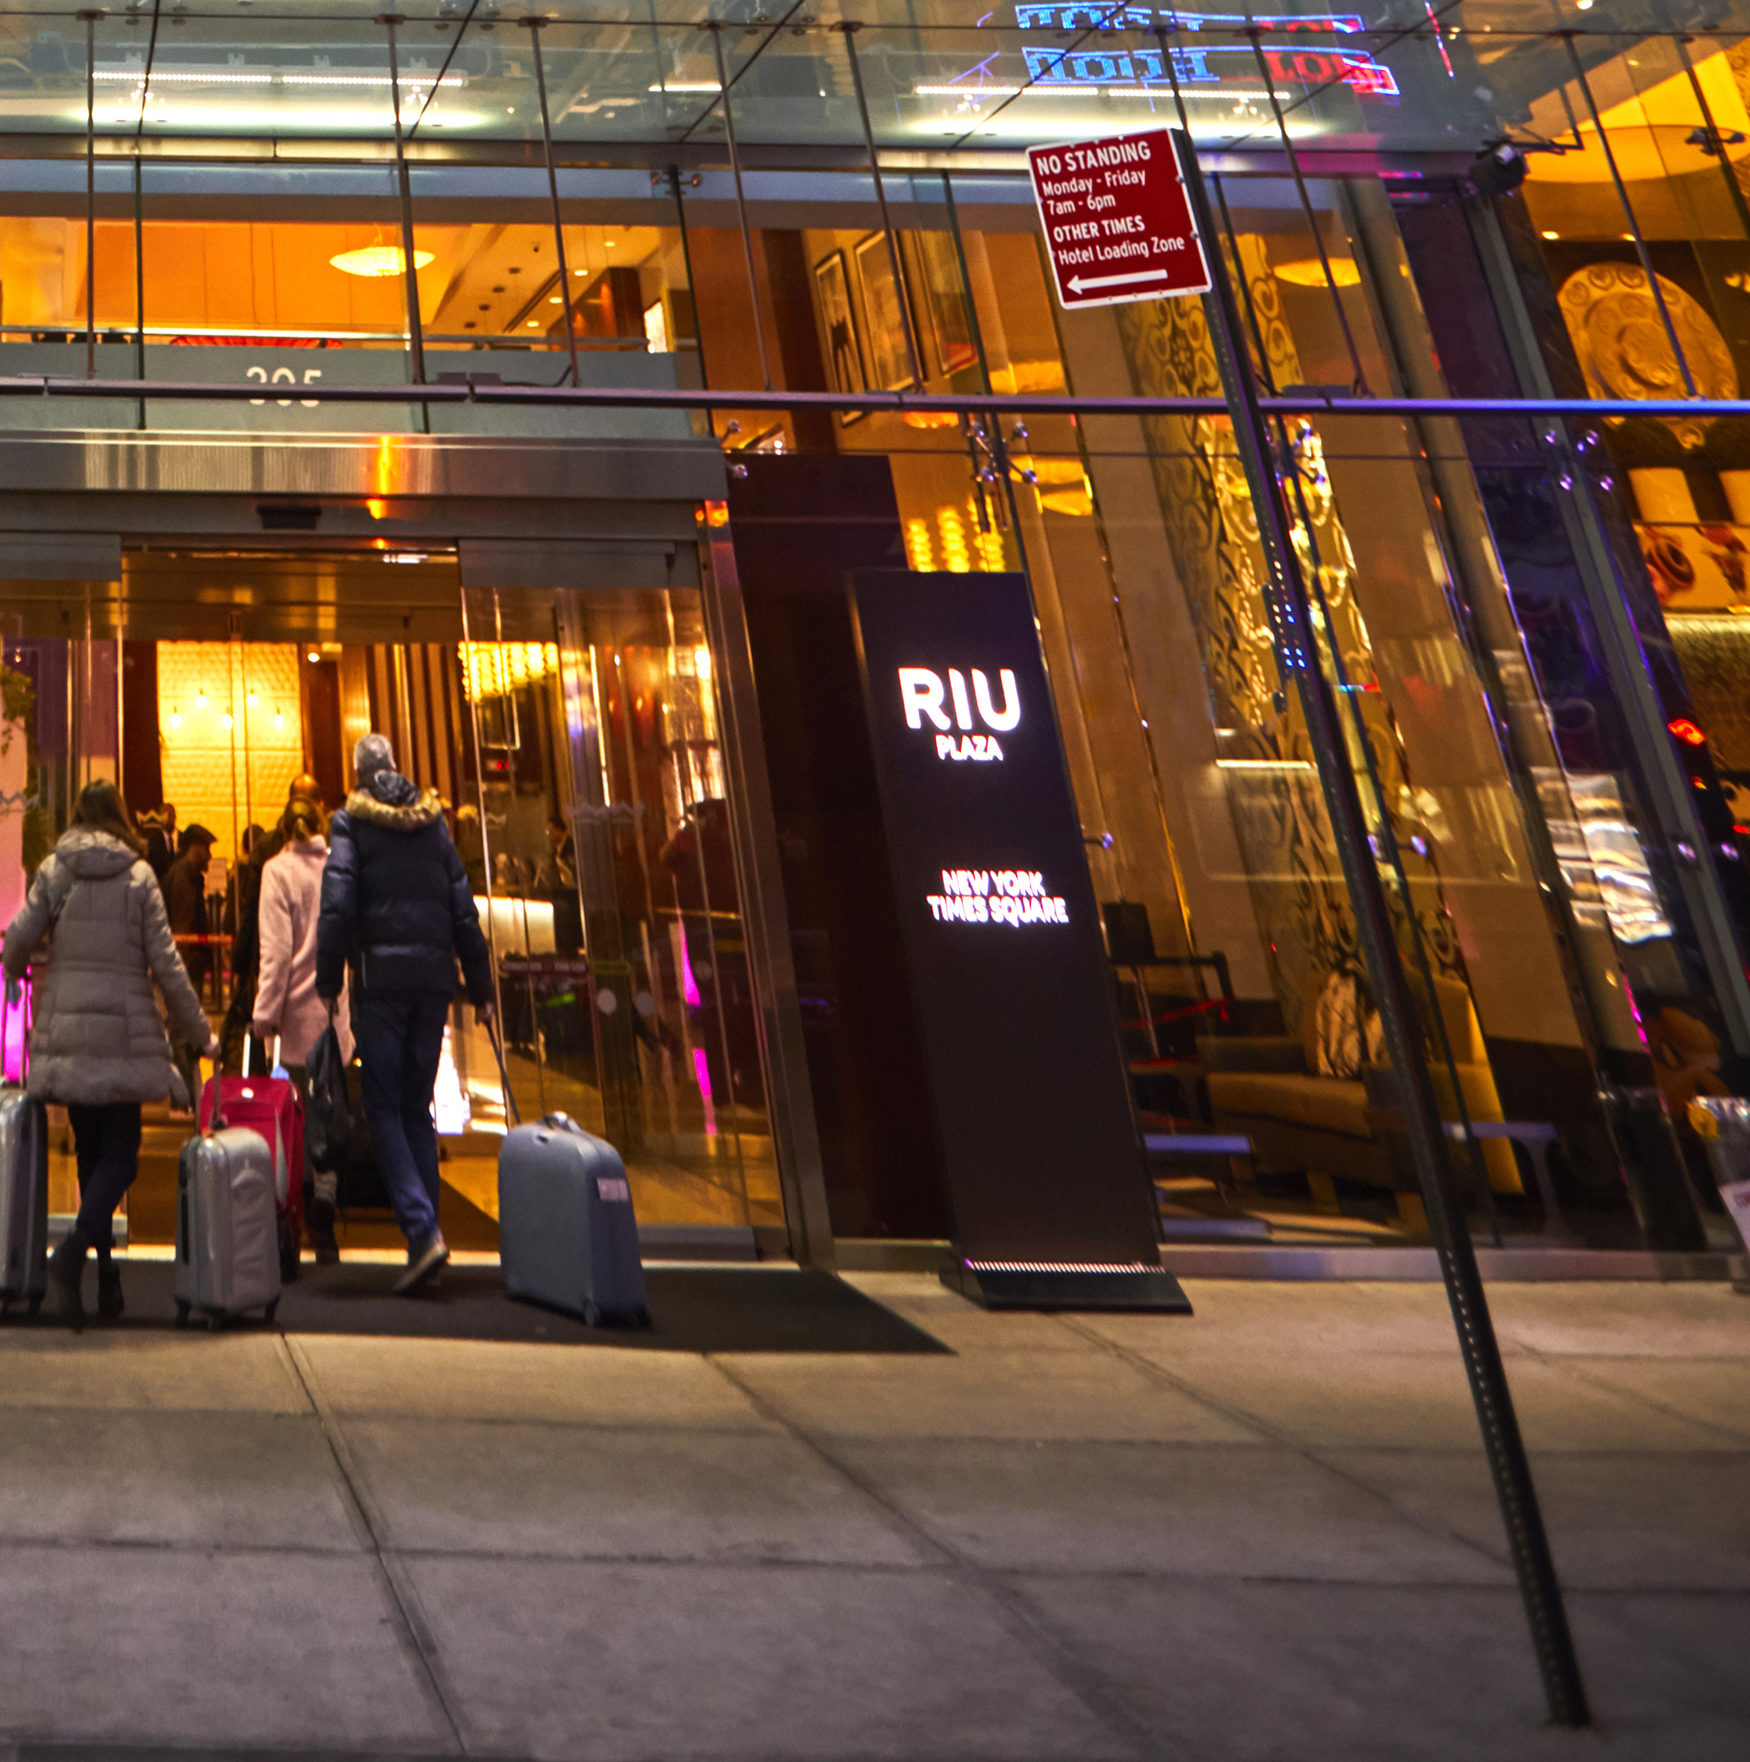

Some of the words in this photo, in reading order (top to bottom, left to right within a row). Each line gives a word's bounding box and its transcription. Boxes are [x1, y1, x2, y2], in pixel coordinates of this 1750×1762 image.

[1036, 155, 1061, 176] NO
[1064, 141, 1151, 172] STANDING
[1042, 177, 1093, 197] Monday
[1104, 170, 1146, 187] Friday
[1047, 199, 1076, 216] 7am
[1087, 193, 1116, 212] 6pm
[1053, 221, 1100, 243] OTHER
[1101, 215, 1145, 236] TIMES
[1058, 246, 1094, 265] Hotel
[1096, 242, 1149, 260] Loading
[1151, 236, 1185, 254] Zone
[898, 667, 1021, 732] RIU
[935, 734, 1003, 761] PLAZA
[942, 869, 989, 896] NEW
[990, 870, 1046, 897] YORK
[926, 895, 988, 922] TIMES
[988, 895, 1069, 928] SQUARE
